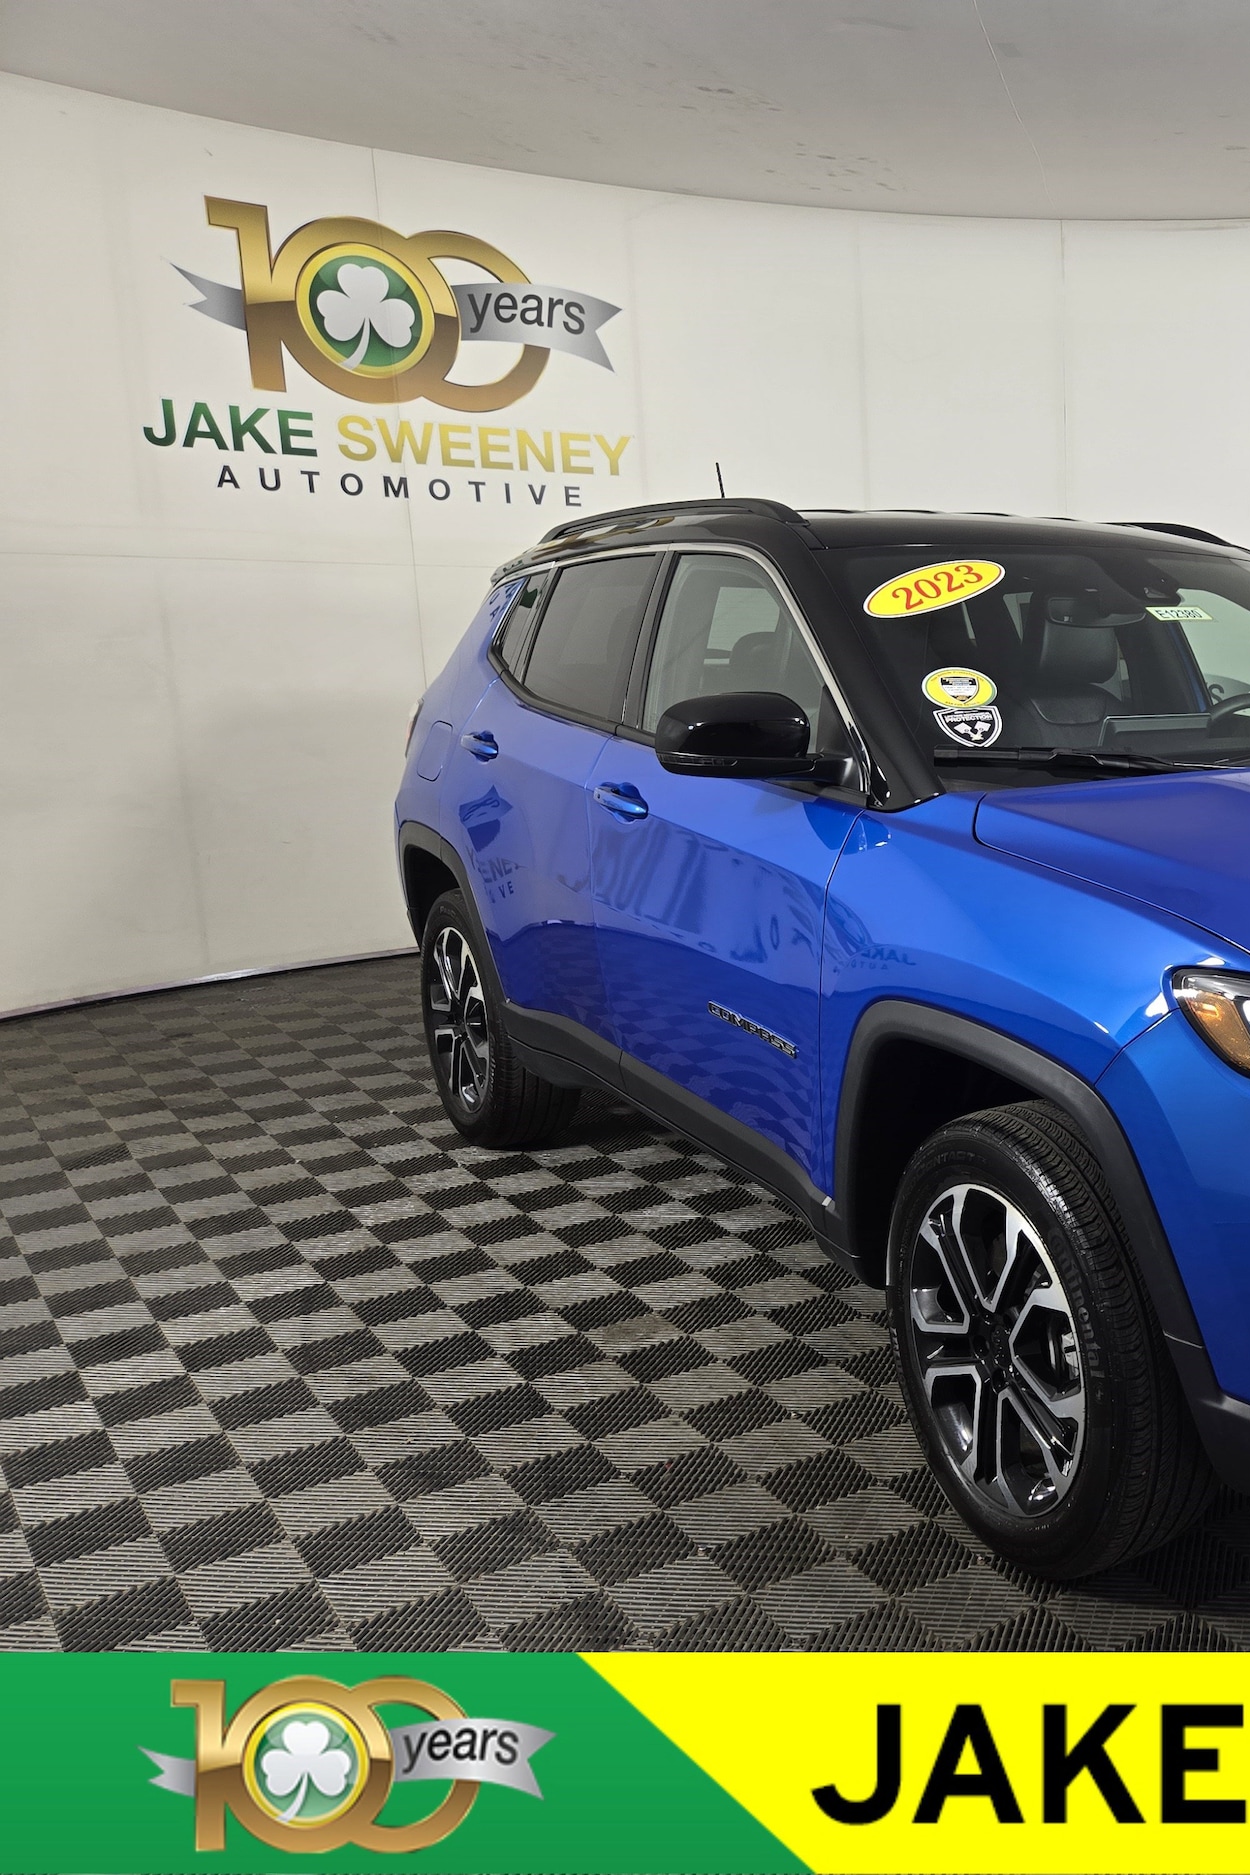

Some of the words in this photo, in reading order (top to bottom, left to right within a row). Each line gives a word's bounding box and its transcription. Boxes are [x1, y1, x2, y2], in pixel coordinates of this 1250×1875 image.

[204, 195, 550, 412] 100
[468, 288, 586, 335] years
[142, 398, 318, 457] JAKE
[337, 415, 632, 476] SWEENEY
[216, 464, 582, 507] AUTOMOTIVE
[892, 564, 983, 611] 2023
[708, 1000, 798, 1059] COMPASS
